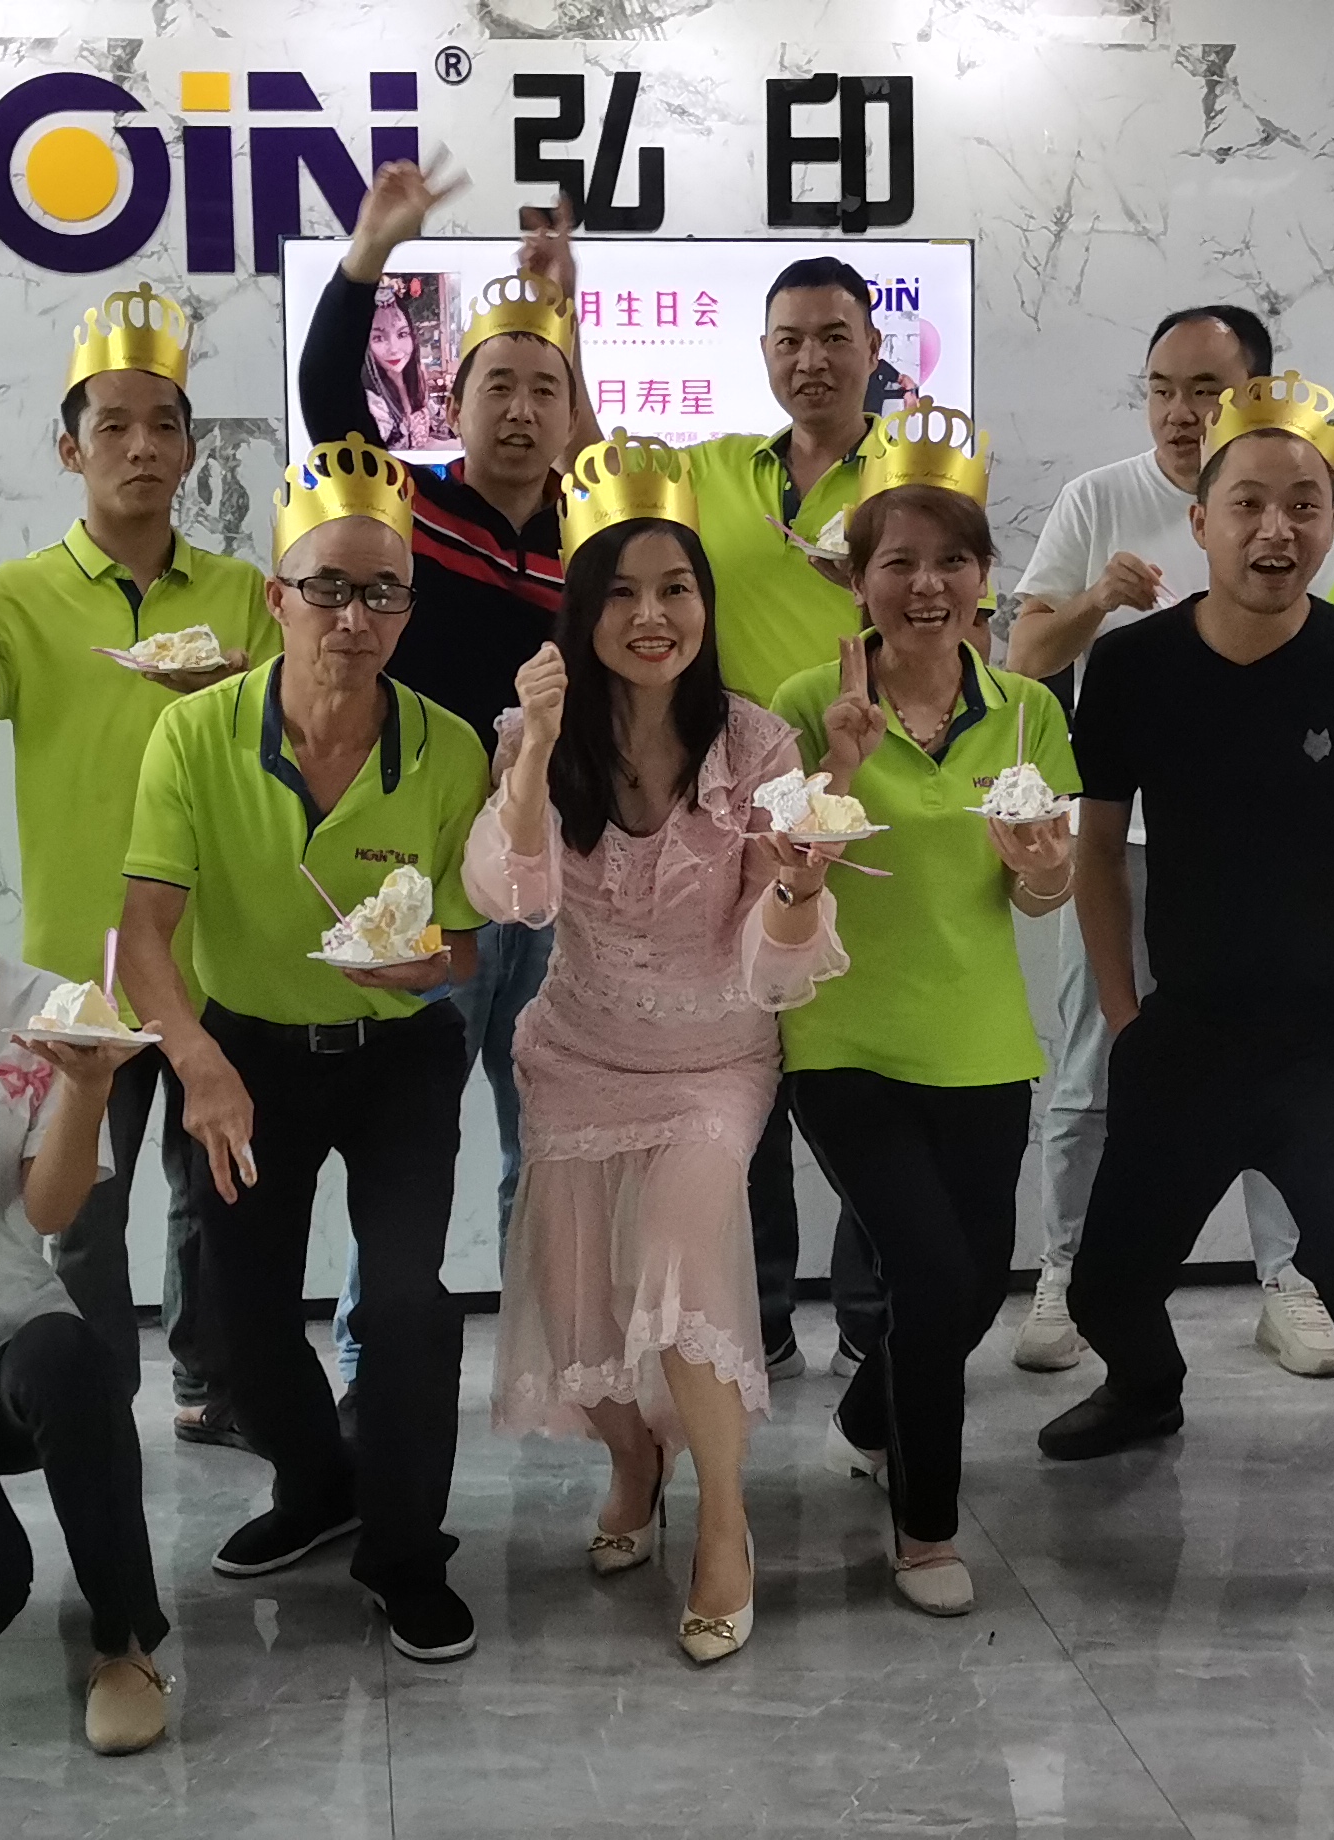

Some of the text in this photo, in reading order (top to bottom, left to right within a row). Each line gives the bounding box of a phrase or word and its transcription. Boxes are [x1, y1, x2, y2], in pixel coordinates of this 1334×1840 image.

[578, 290, 719, 328] 月生日会
[596, 378, 715, 416] 月寿星
